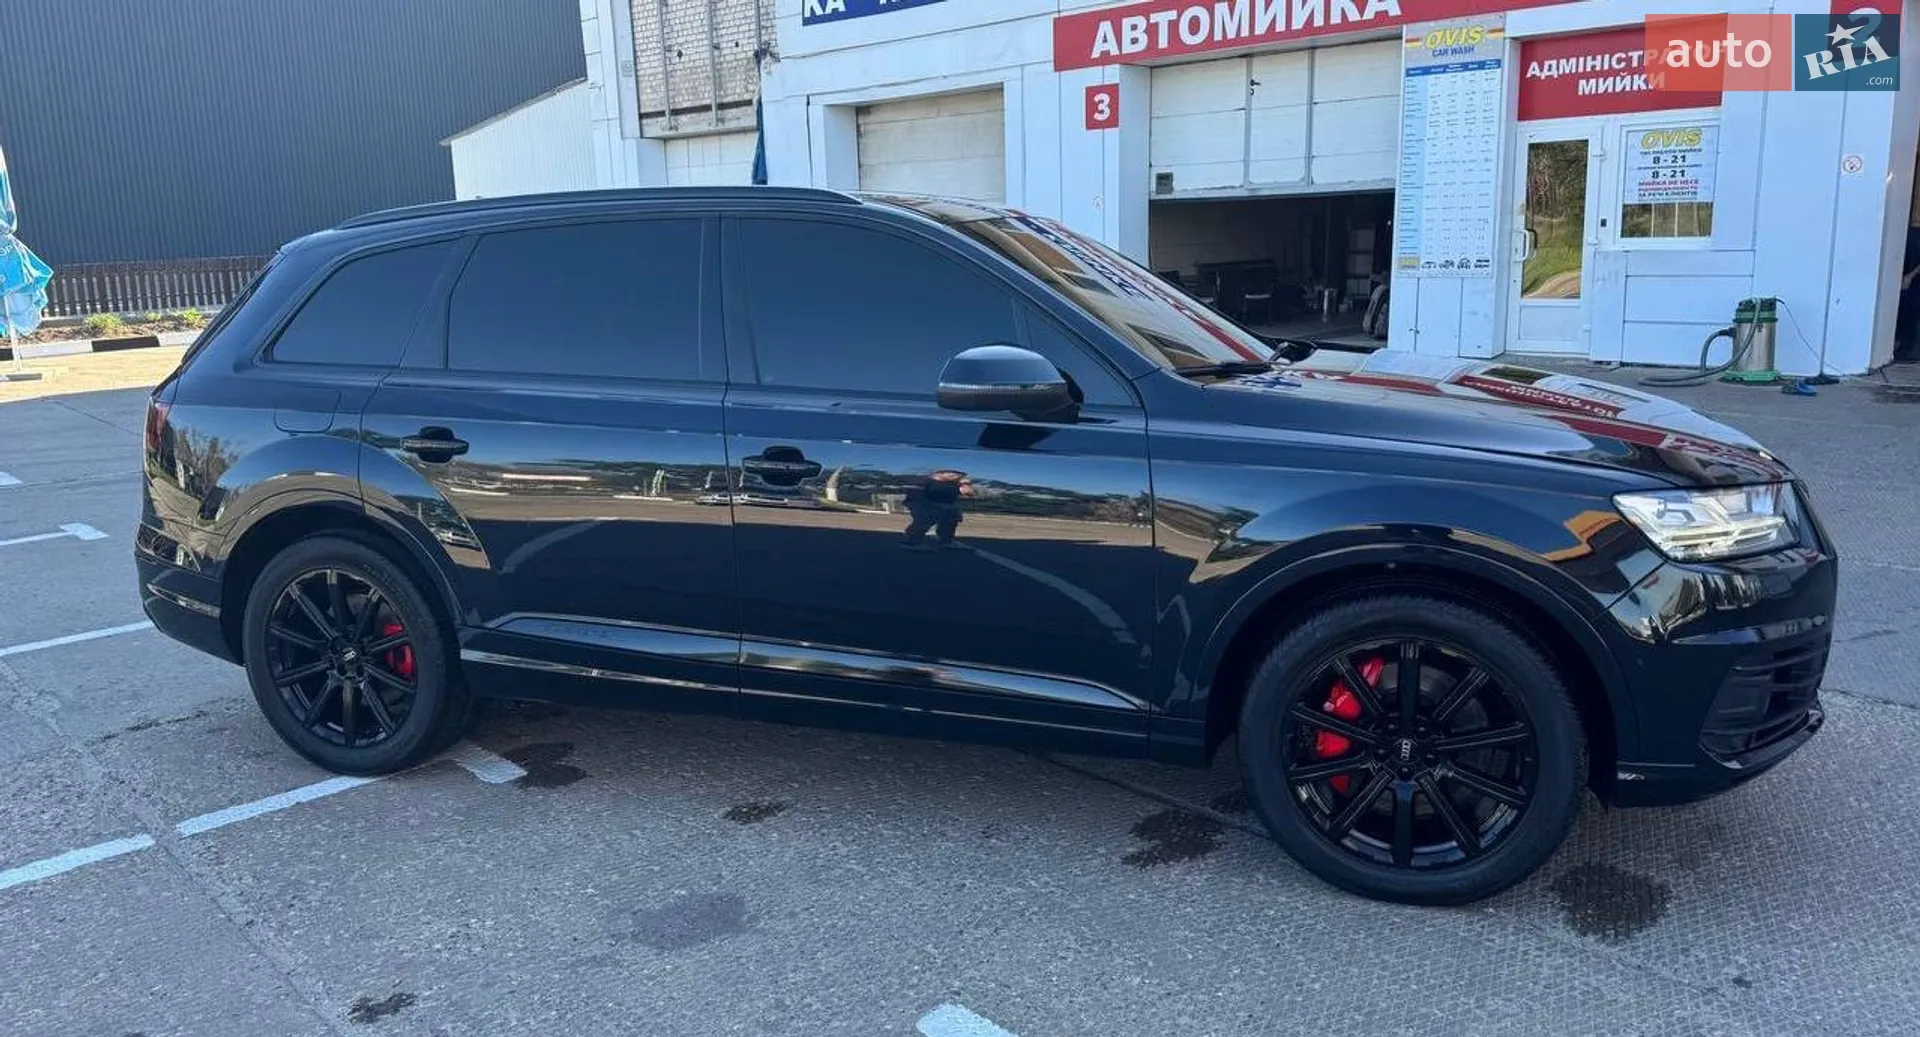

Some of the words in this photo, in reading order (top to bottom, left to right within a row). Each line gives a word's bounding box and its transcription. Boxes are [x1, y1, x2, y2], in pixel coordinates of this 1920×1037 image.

[1577, 71, 1665, 96] МИЙКИ
[1093, 93, 1111, 121] 3
[1641, 129, 1703, 149] OVIS
[1652, 155, 1660, 164] 8
[1671, 154, 1686, 163] 21
[1651, 170, 1660, 179] 8
[1670, 169, 1686, 178] 21
